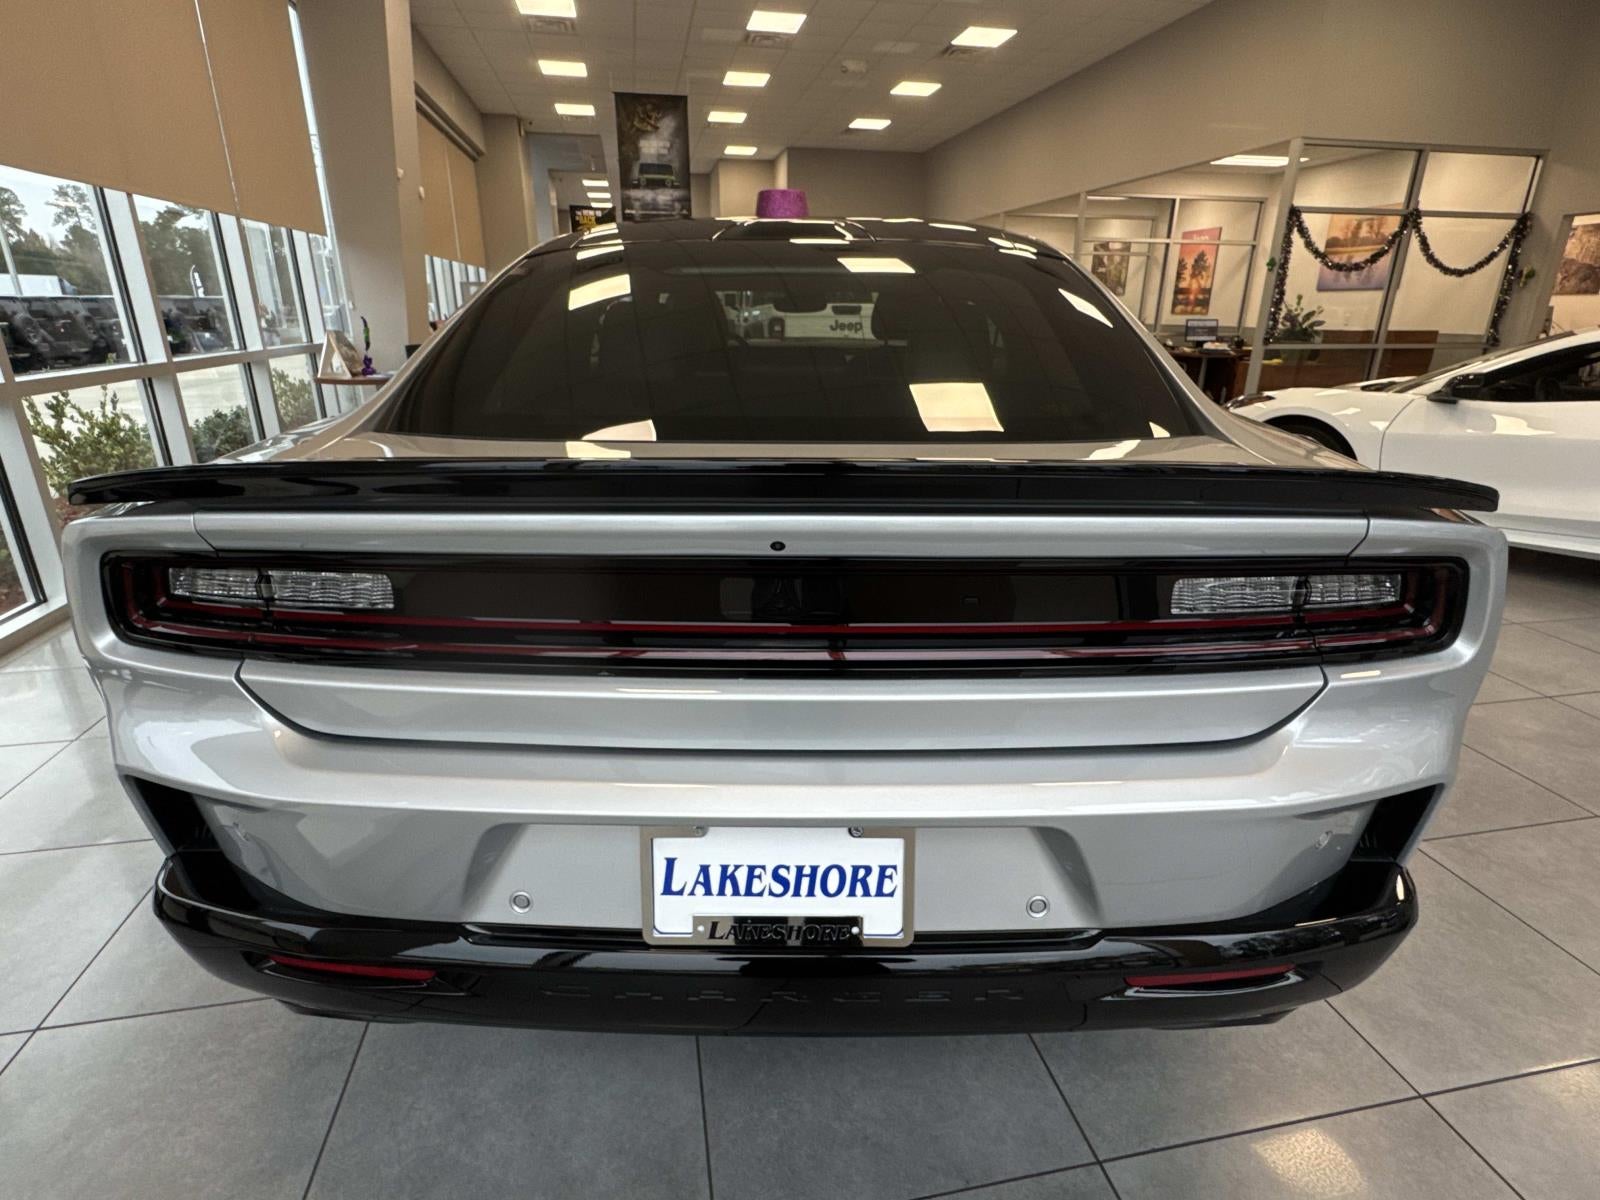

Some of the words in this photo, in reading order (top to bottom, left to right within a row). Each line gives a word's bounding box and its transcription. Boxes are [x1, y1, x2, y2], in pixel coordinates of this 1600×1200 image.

[829, 320, 863, 333] Jeep
[660, 857, 898, 898] LAKESHORE
[708, 920, 850, 941] LAKESHORE
